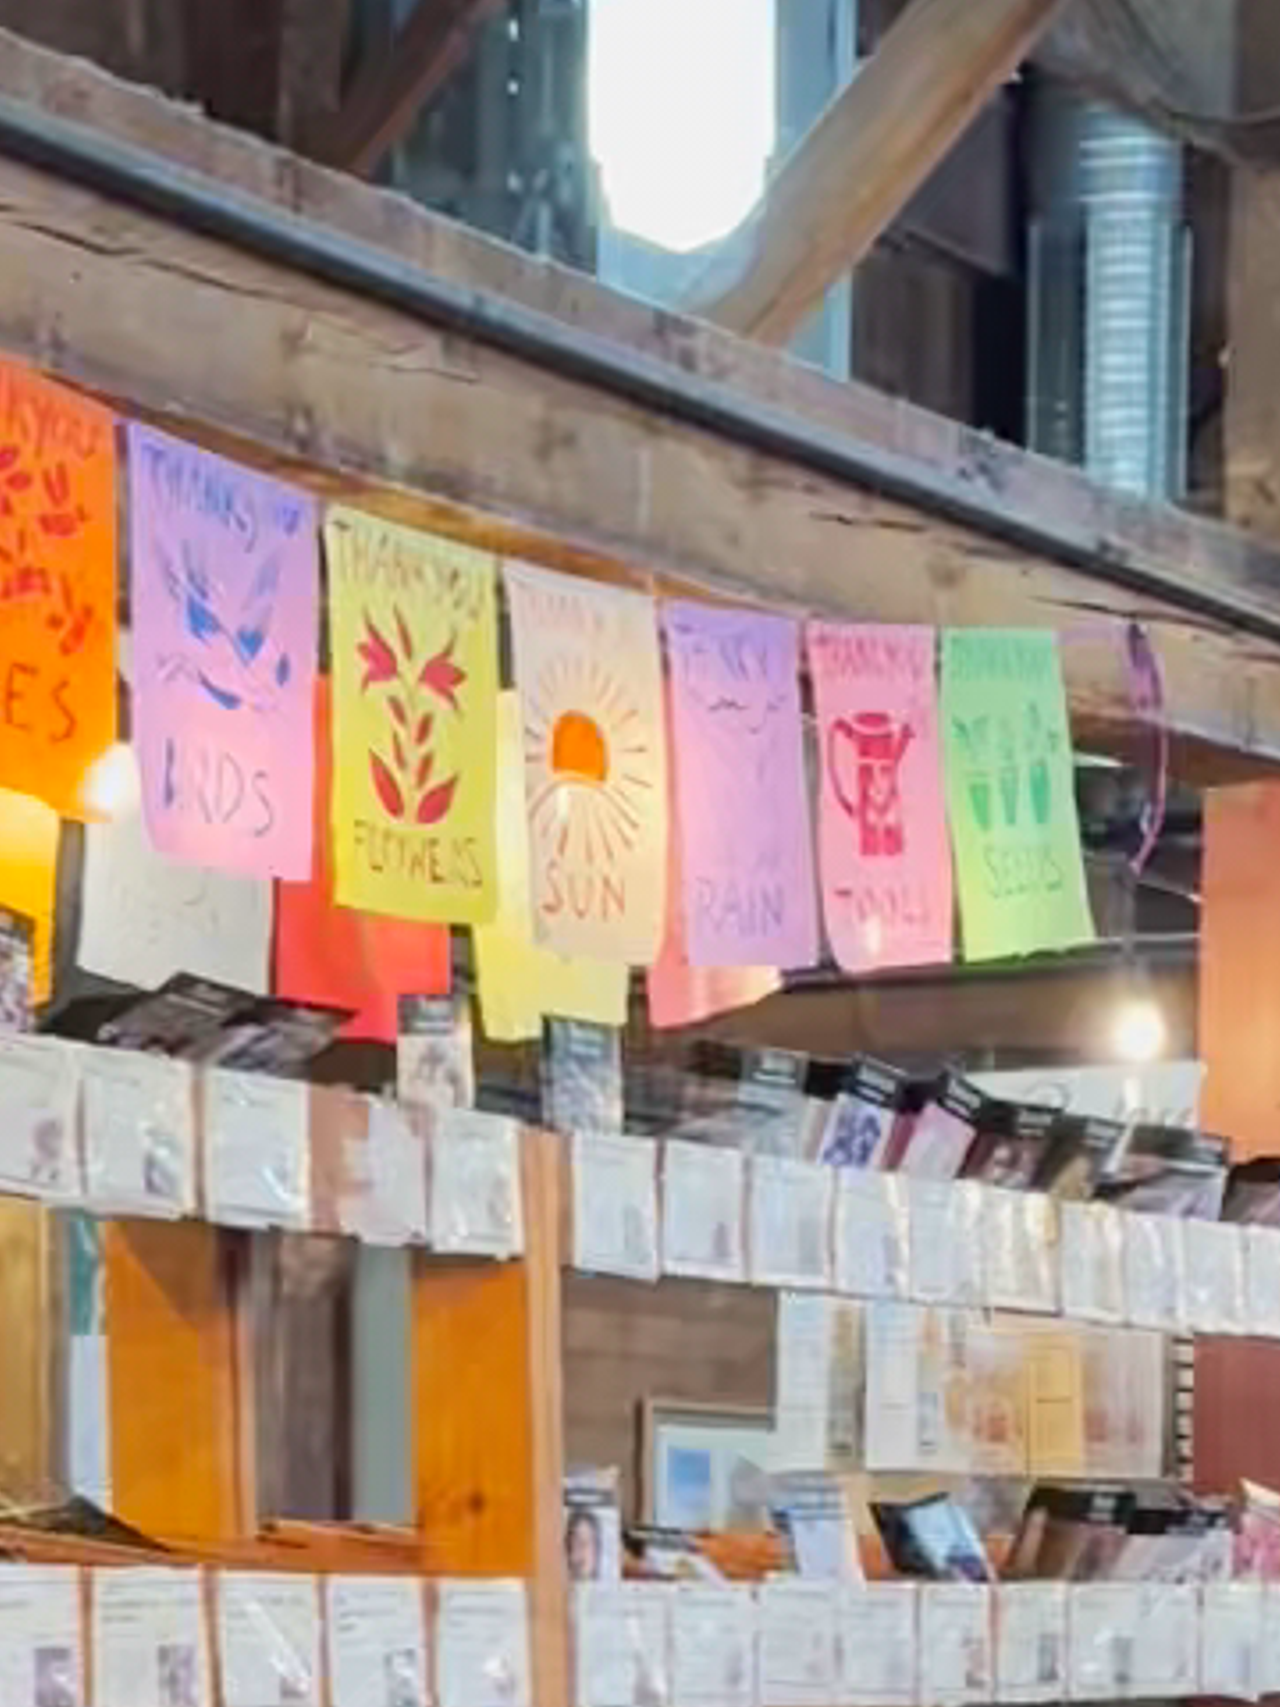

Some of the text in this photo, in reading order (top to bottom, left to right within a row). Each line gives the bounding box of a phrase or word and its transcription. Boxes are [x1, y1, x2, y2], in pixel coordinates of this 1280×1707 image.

[353, 817, 483, 889] FLOWERS
[982, 841, 1063, 900] SEEDS
[541, 857, 626, 922] SUN
[694, 875, 785, 939] RAIN
